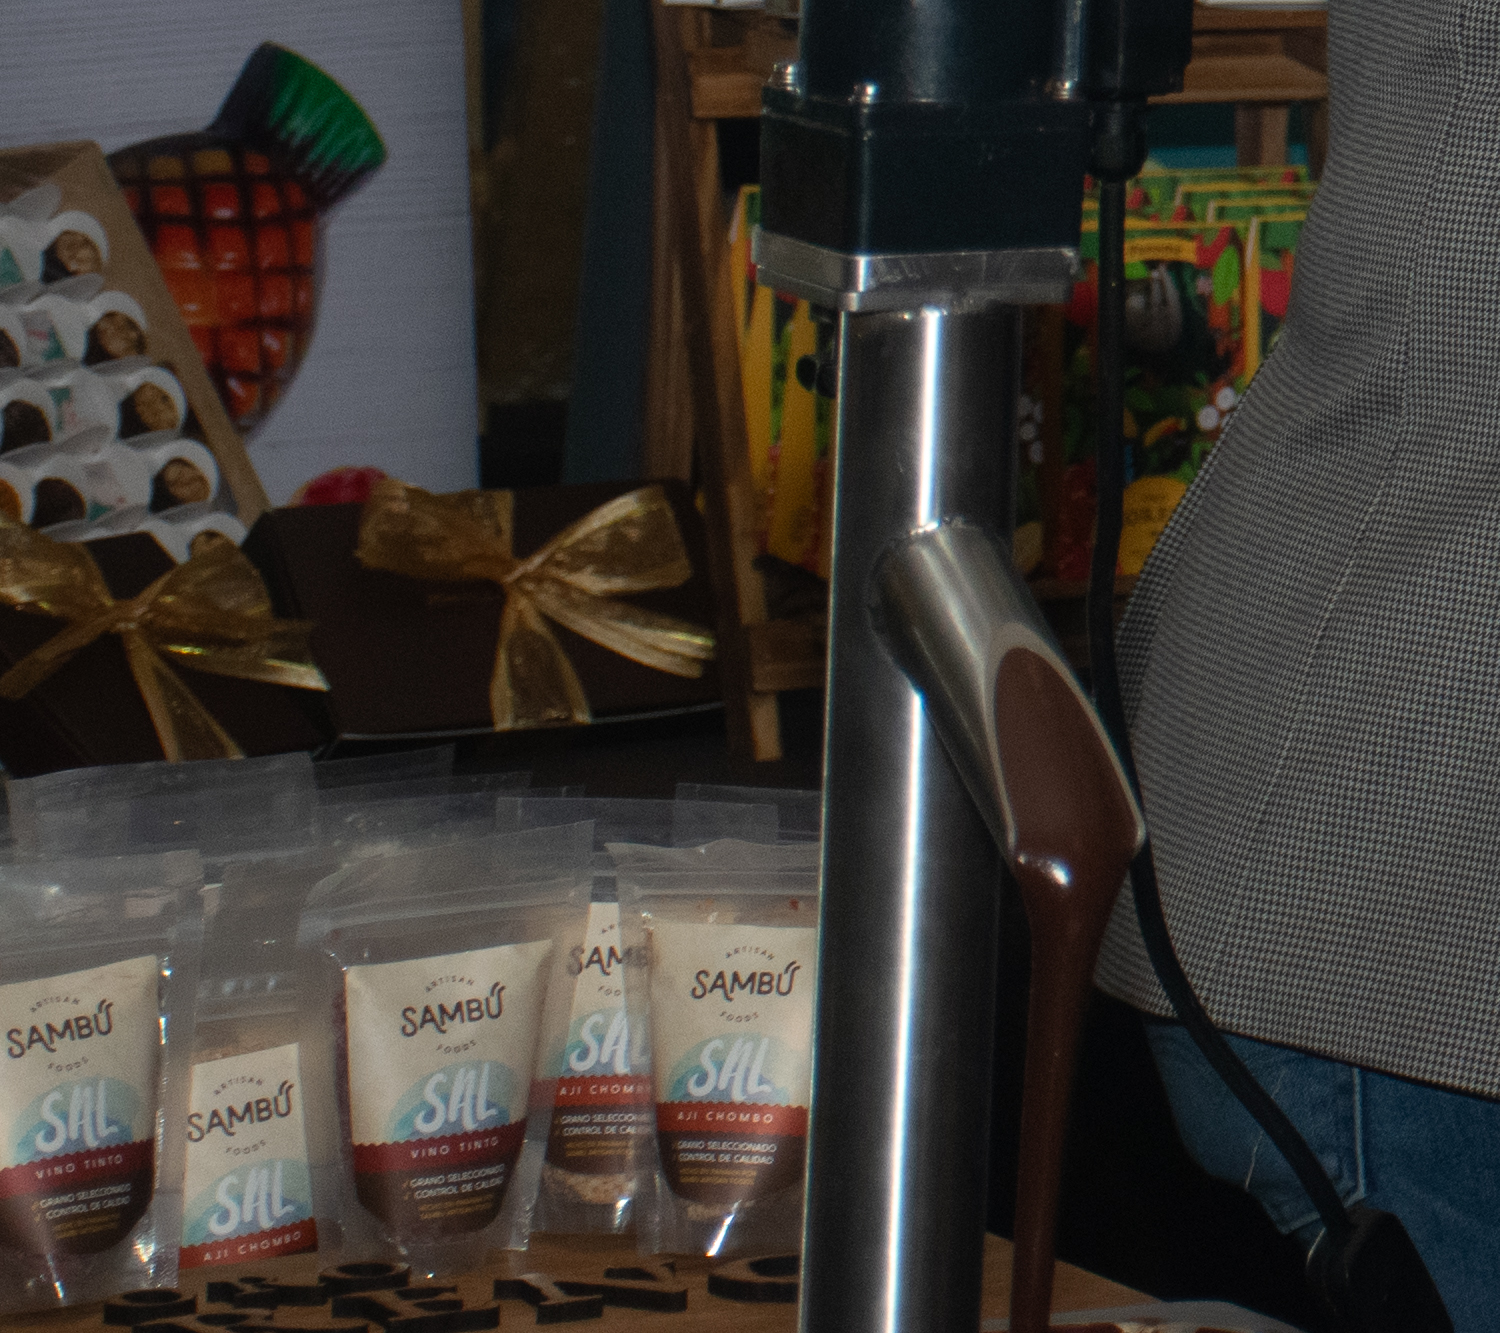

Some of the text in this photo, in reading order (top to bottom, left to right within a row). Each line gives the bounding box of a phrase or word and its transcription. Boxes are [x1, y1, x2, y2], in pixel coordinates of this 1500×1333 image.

[401, 981, 506, 1037] SAMBÚ
[690, 960, 801, 1002] SAMBÚ
[7, 997, 114, 1060] SAMBÚ
[413, 1061, 498, 1135] SAL
[687, 1037, 773, 1103] SAL
[34, 1084, 120, 1154] SAL
[187, 1079, 294, 1143] SAMBÚ
[676, 1110, 774, 1124] AJI CHOMBO
[35, 1153, 124, 1180] VINO TINTO
[410, 1136, 500, 1159] VINO TINTO
[208, 1160, 296, 1236] SAL
[203, 1230, 302, 1263] AJI CHOMBO
